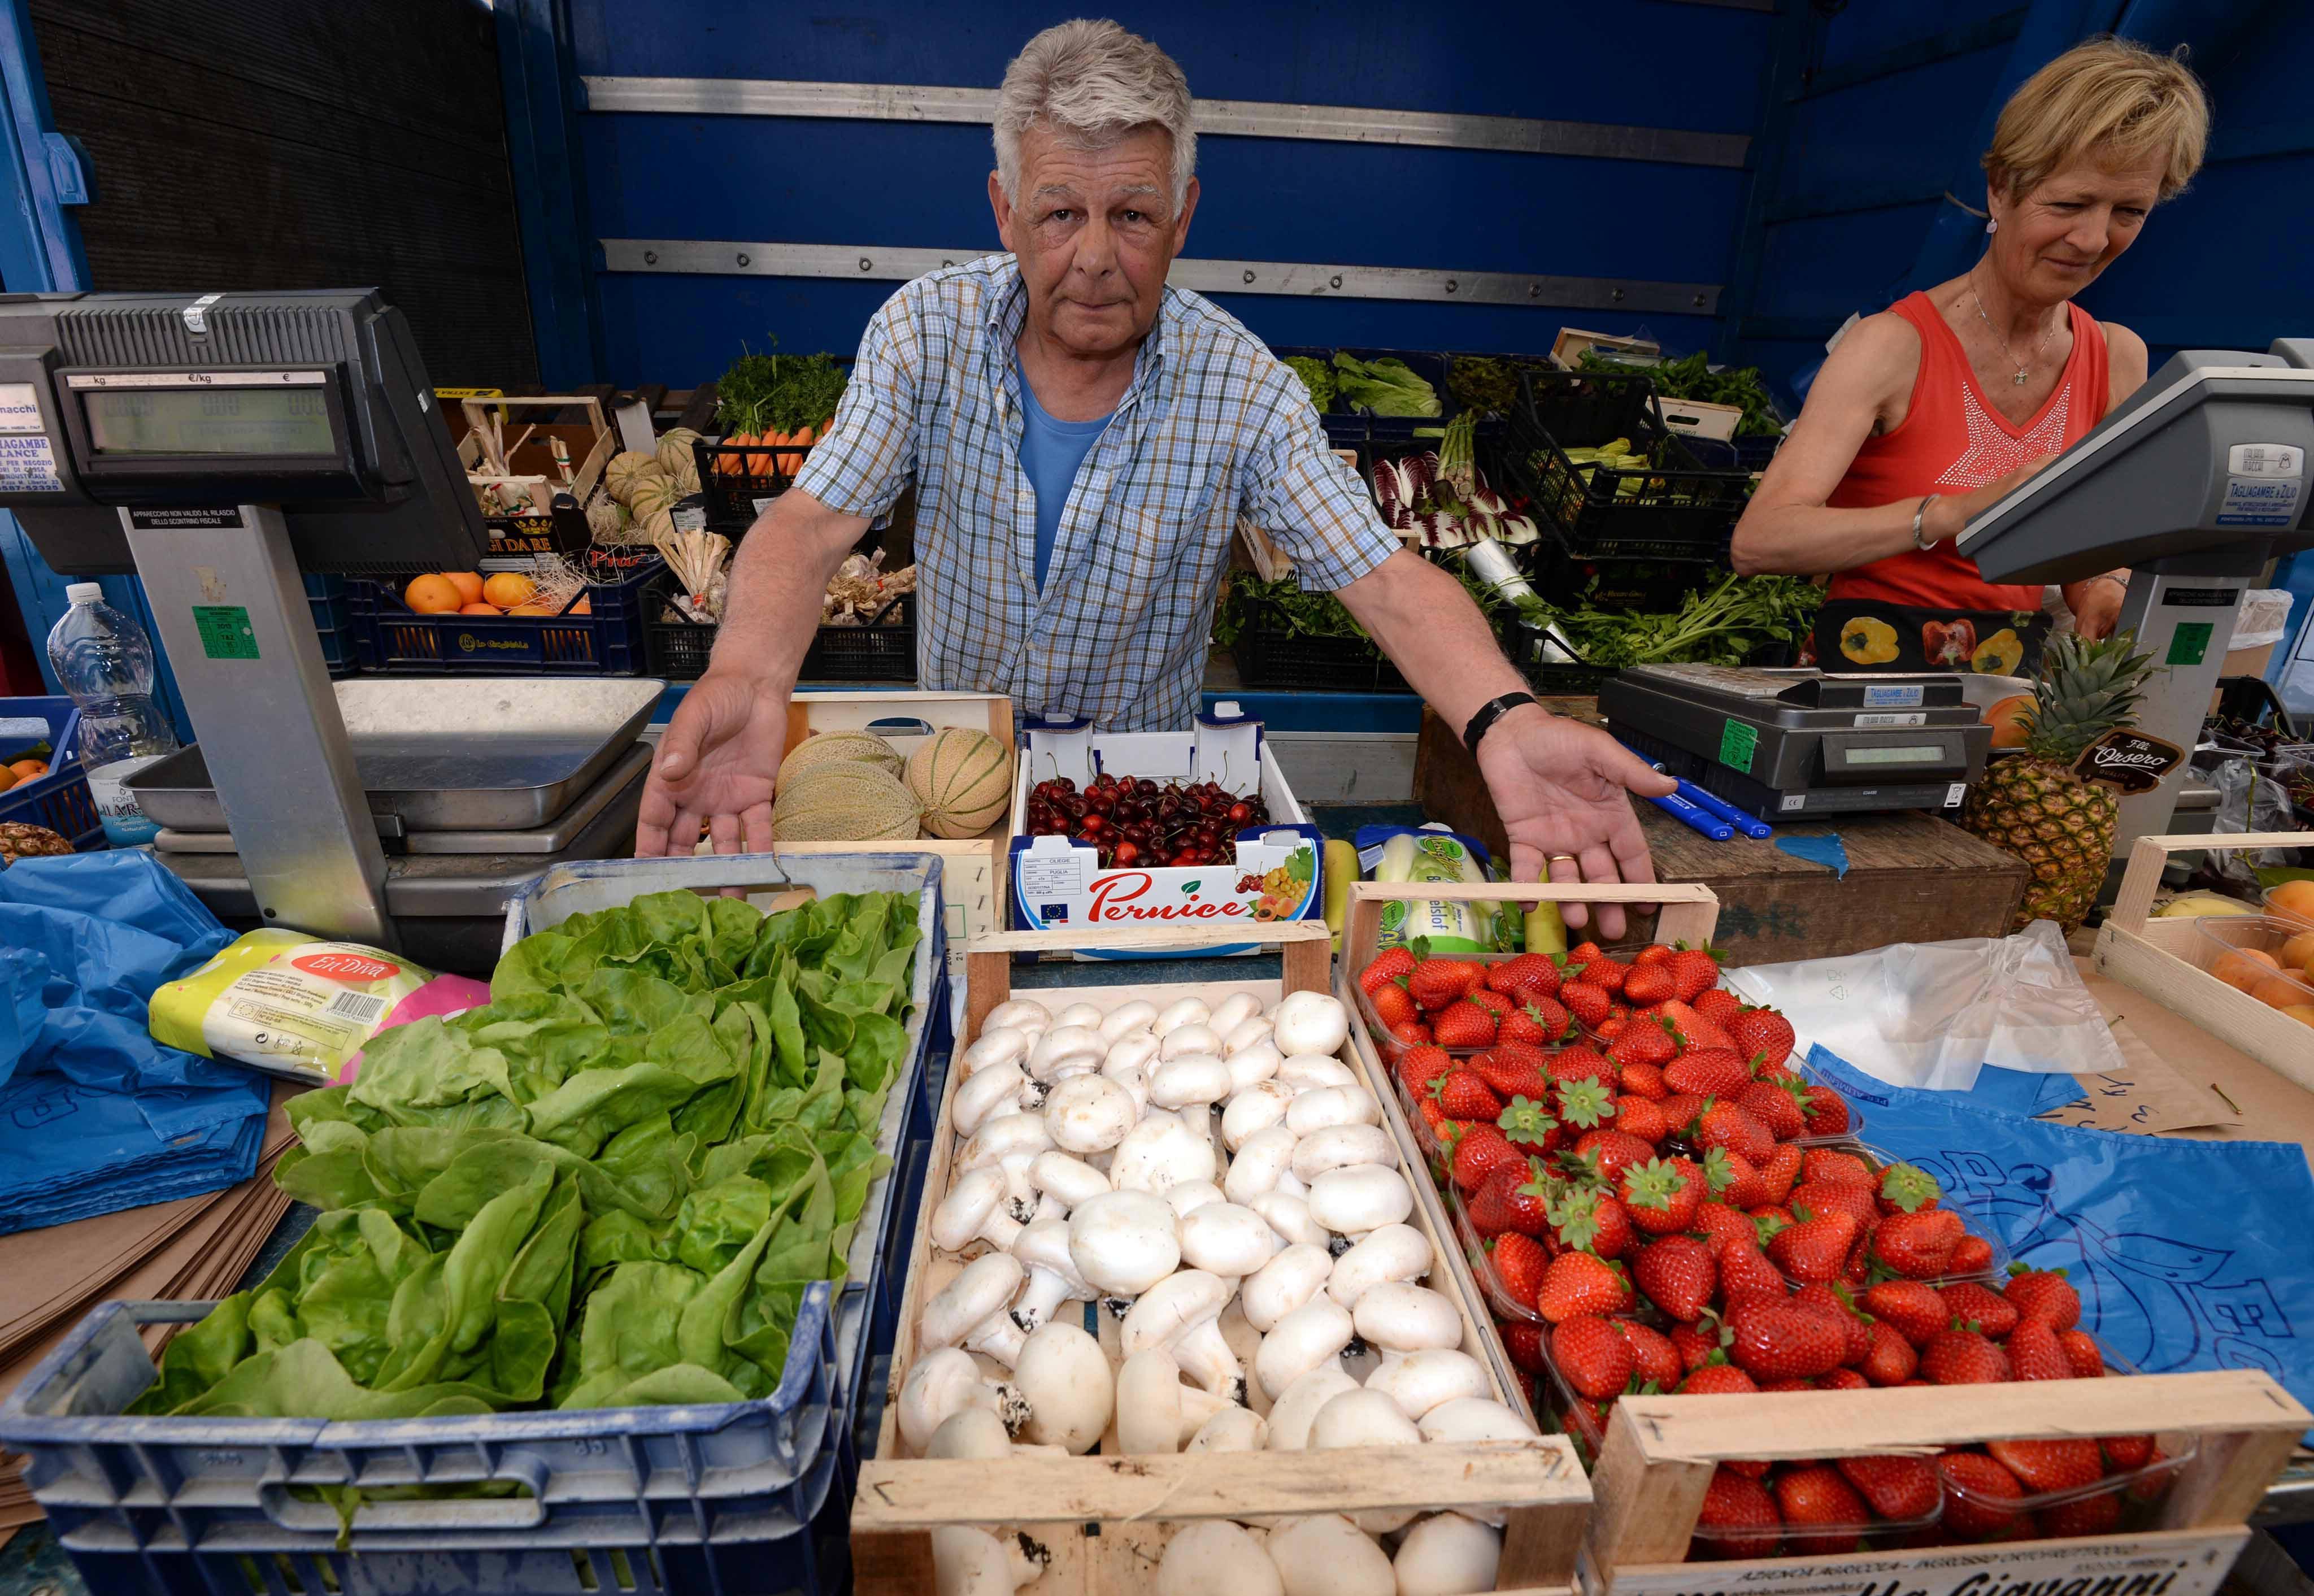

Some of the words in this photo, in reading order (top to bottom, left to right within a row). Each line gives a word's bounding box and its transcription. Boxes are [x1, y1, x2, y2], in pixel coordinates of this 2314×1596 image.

[94, 376, 106, 385] kg
[189, 373, 211, 384] €/kg
[504, 538, 531, 552] DA
[529, 538, 552, 551] RE
[2094, 747, 2169, 766] Orsero
[1088, 872, 1249, 922] Pernice
